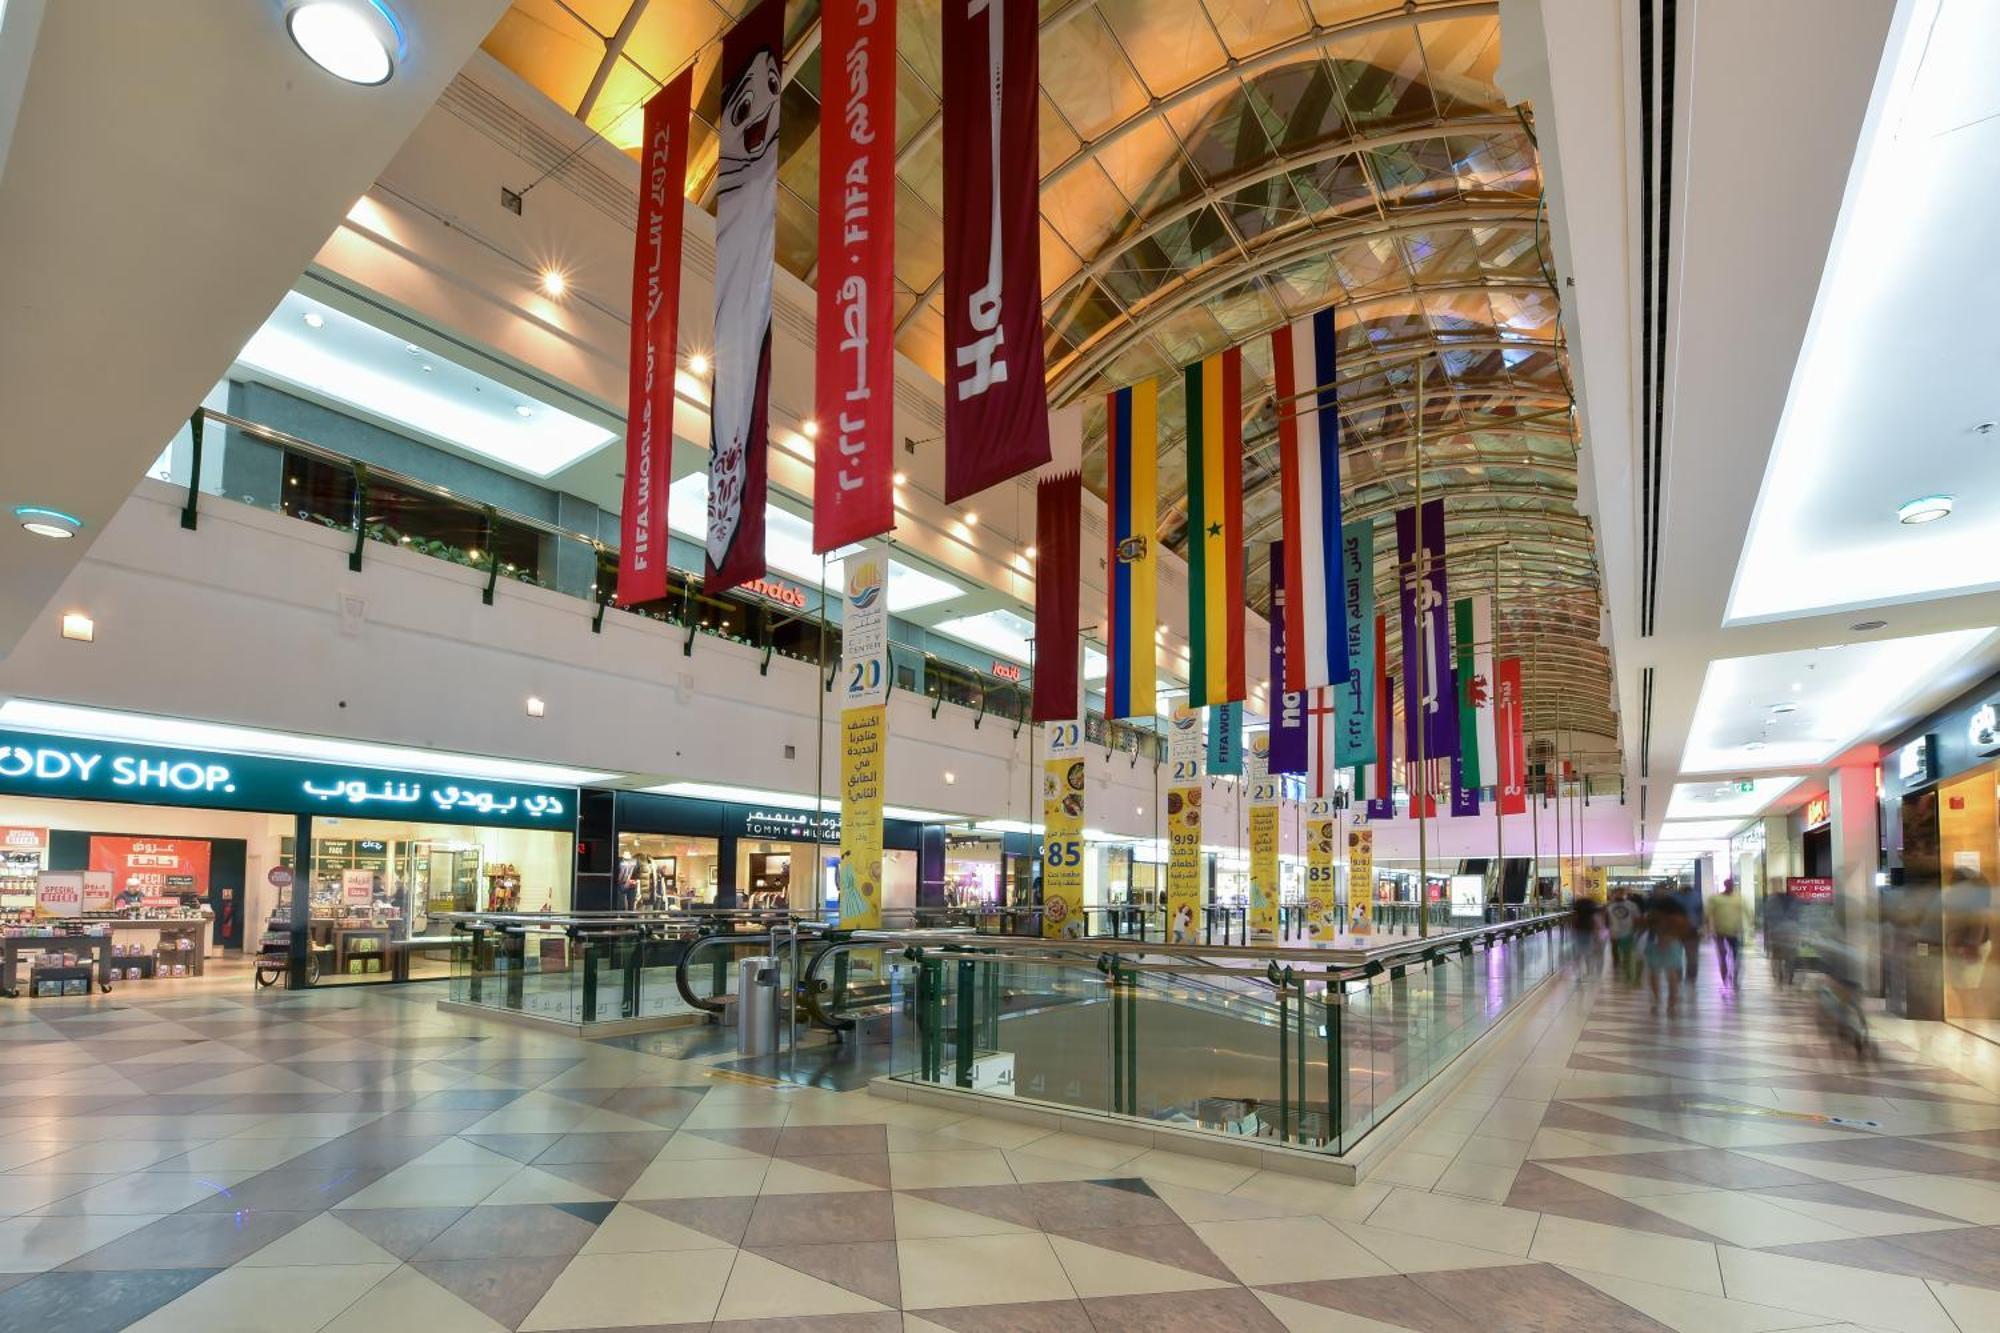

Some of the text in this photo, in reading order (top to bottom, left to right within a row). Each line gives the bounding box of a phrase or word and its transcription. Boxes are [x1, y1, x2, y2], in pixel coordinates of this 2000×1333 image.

[844, 156, 869, 246] FIFA
[836, 275, 871, 401] قطر
[634, 511, 650, 571] FIFA
[1344, 537, 1362, 573] كأس
[1347, 579, 1363, 619] العالم
[1349, 622, 1360, 657] FIFA
[849, 659, 881, 693] 20
[848, 716, 879, 730] اكتشف
[1219, 704, 1230, 763] FIFA WOR
[1052, 724, 1079, 748] 20
[855, 760, 870, 771] في
[1173, 760, 1197, 778] 20
[432, 786, 517, 813] بودي
[1254, 784, 1274, 799] 20
[1311, 802, 1328, 813] 20
[746, 823, 788, 835] TOMMY
[1171, 831, 1199, 845] زوروا
[1047, 842, 1081, 867] 85
[1309, 867, 1331, 881] 85
